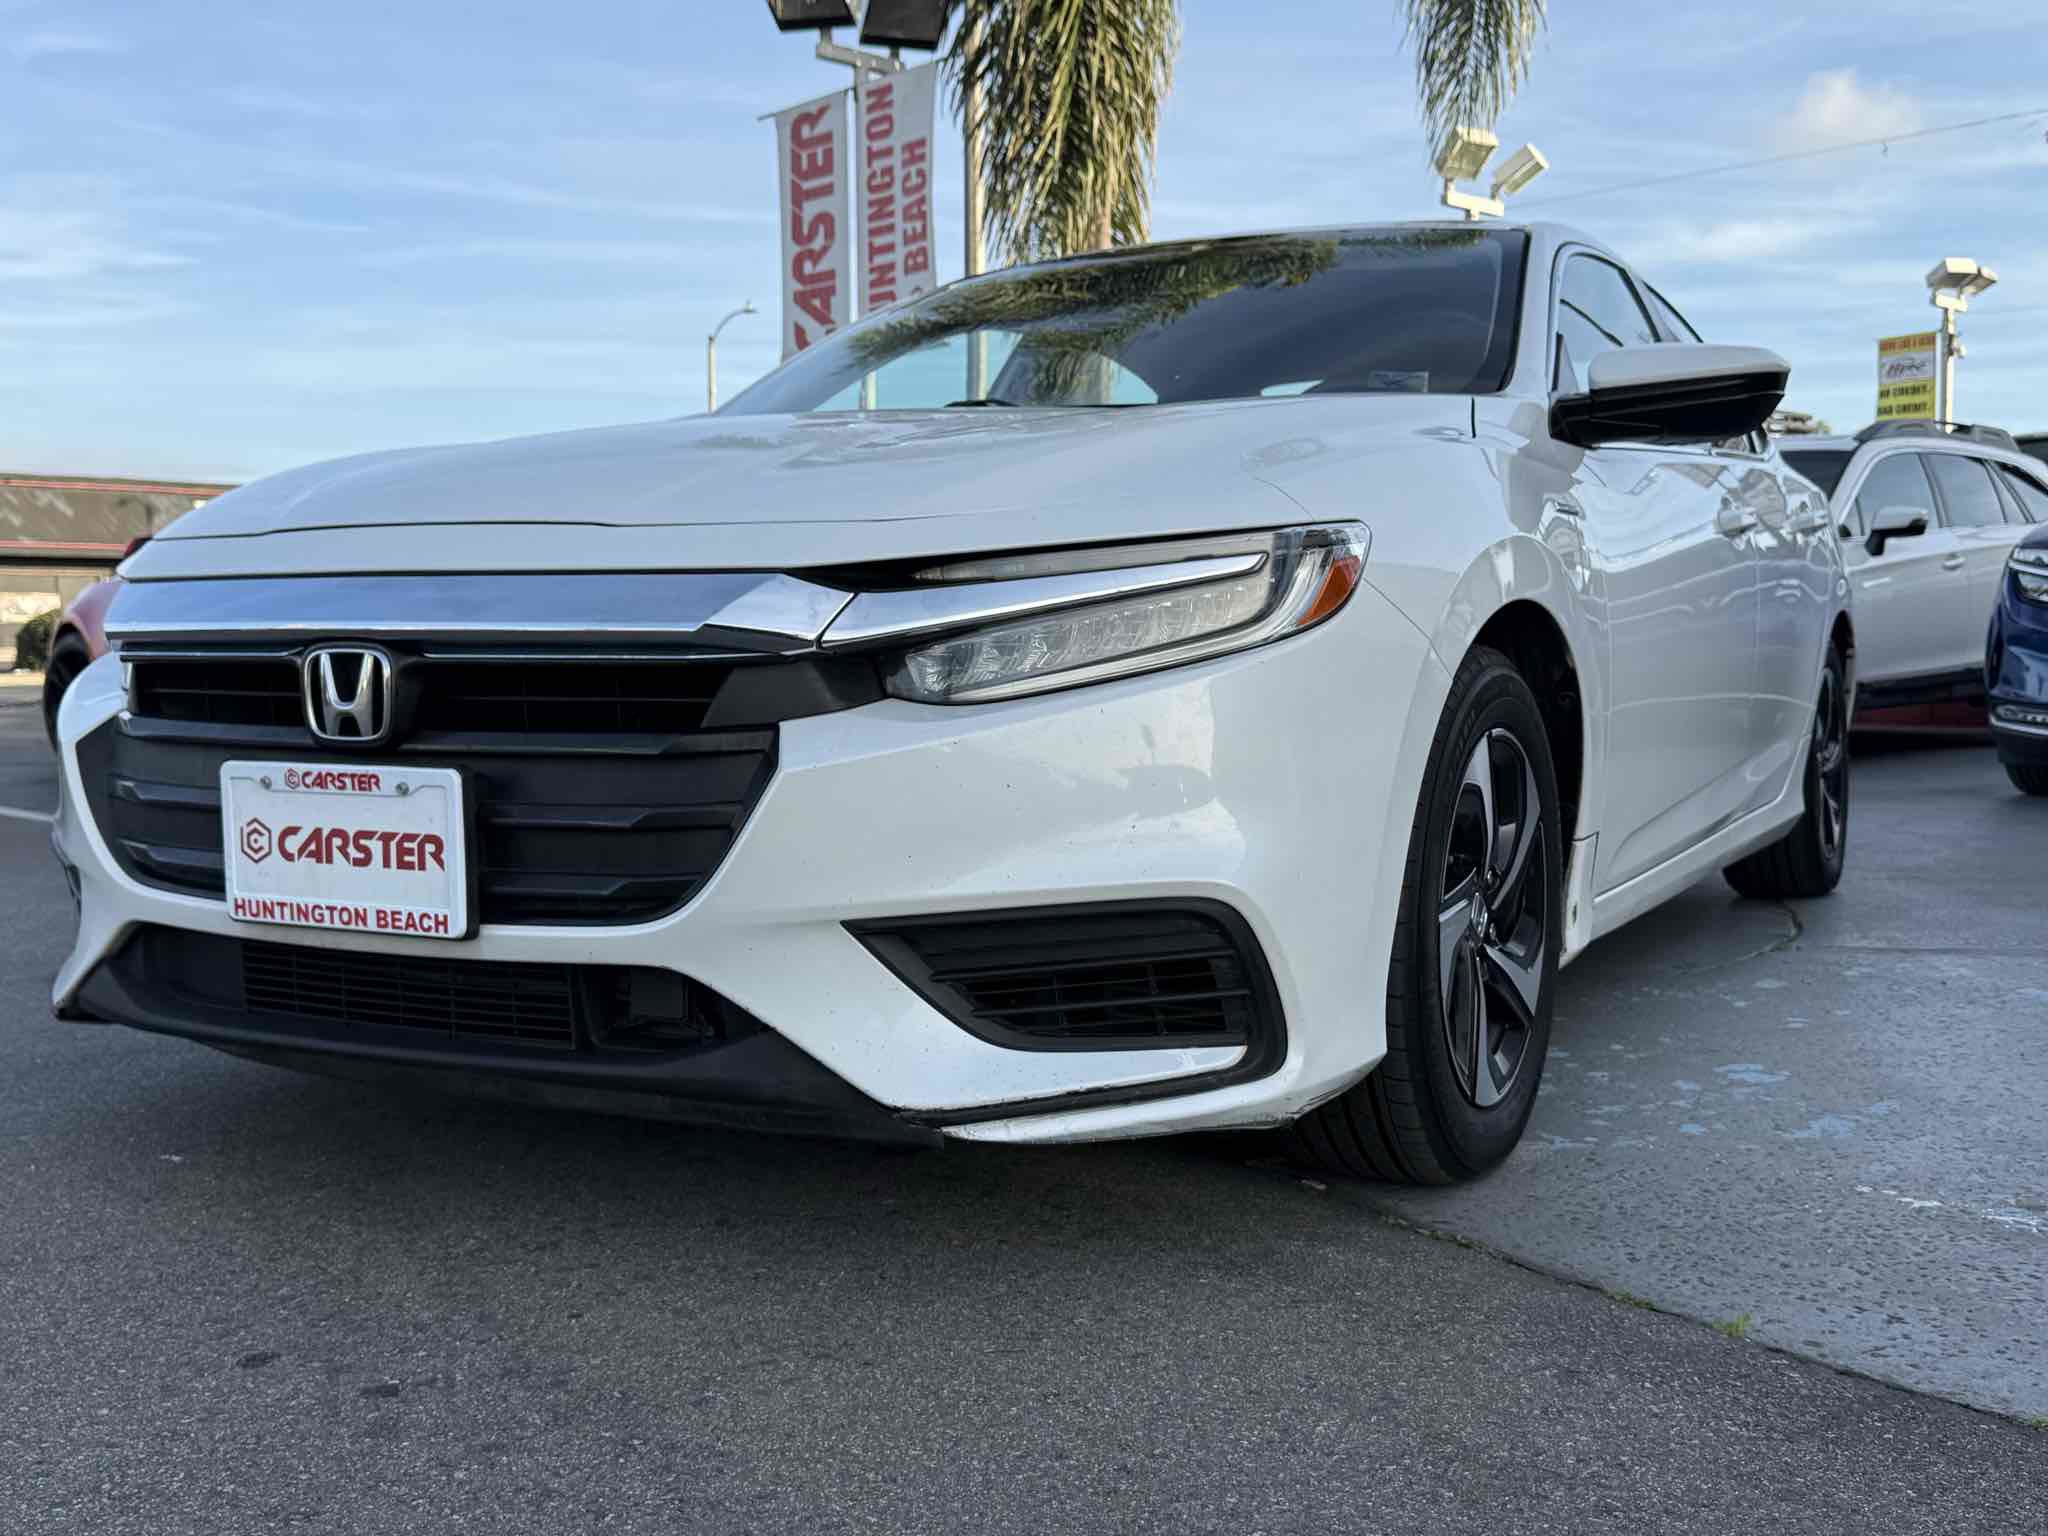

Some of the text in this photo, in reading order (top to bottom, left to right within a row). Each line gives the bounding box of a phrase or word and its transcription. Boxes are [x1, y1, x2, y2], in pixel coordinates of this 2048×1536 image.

[902, 137, 929, 276] BEACH
[301, 771, 381, 791] CARSTER
[278, 826, 446, 872] CARSTER
[234, 897, 449, 934] HUNTINGTON BEACH
